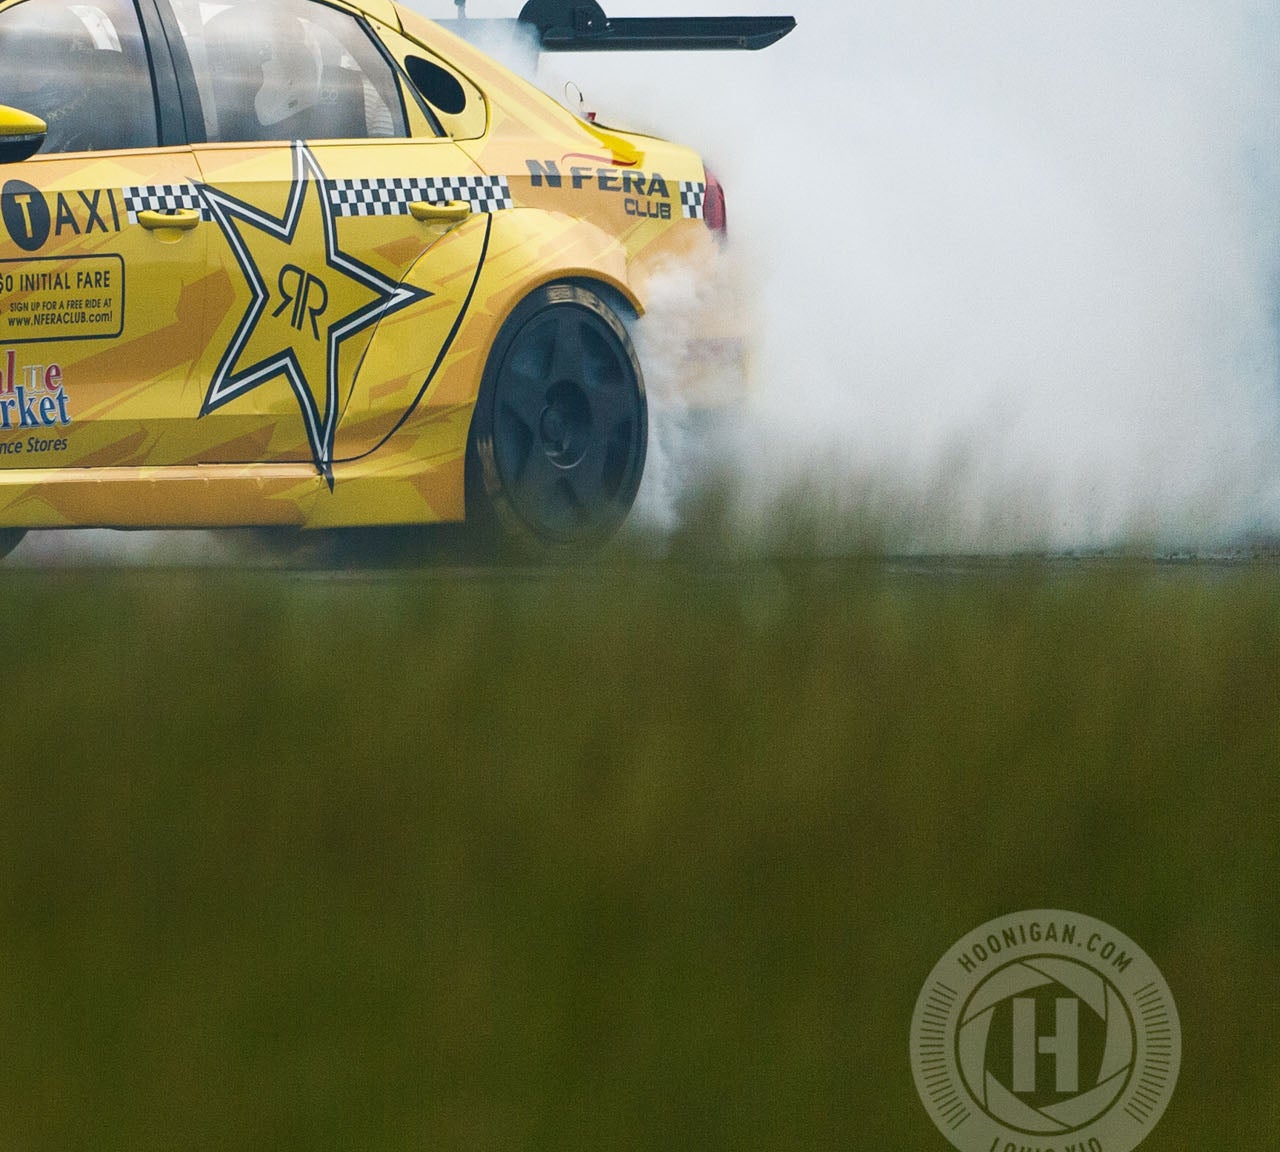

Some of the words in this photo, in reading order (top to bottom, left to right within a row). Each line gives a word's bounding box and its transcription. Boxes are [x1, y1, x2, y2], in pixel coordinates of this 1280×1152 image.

[569, 165, 670, 198] FERA
[13, 188, 120, 239] TAXI
[624, 198, 671, 220] CLUB
[20, 272, 71, 292] INITIAL
[77, 270, 110, 288] FARE
[10, 302, 29, 312] SIGN
[31, 301, 40, 311] UP
[42, 301, 56, 311] FOR
[59, 300, 65, 310] A
[67, 299, 83, 310] FREE
[85, 298, 101, 308] RIDE
[103, 298, 113, 308] AT
[26, 436, 68, 453] Stores
